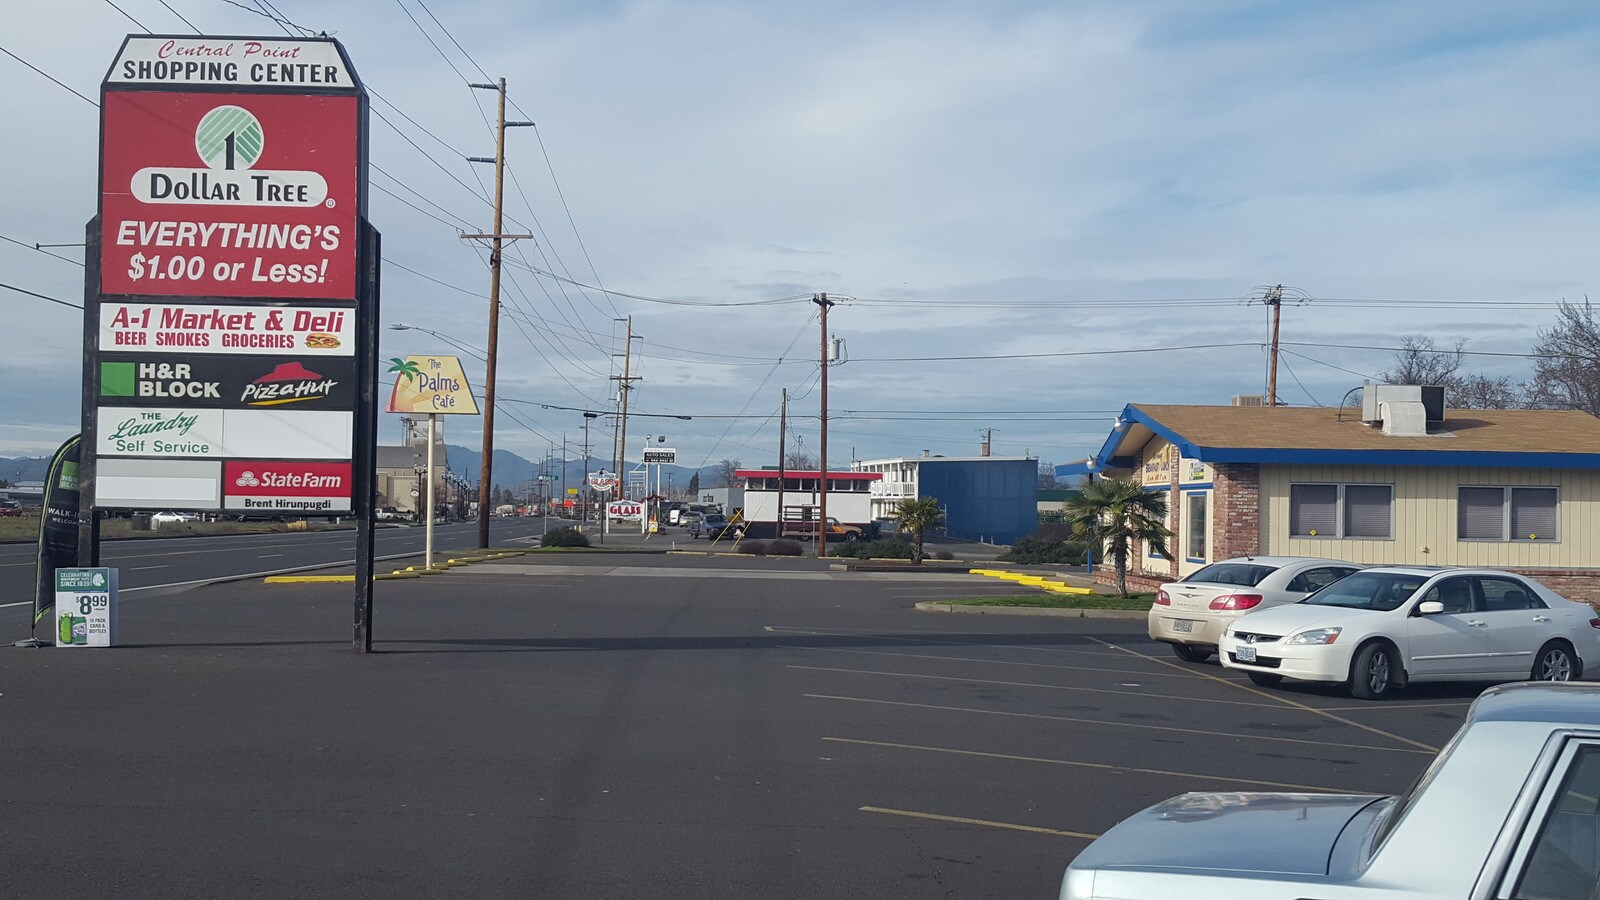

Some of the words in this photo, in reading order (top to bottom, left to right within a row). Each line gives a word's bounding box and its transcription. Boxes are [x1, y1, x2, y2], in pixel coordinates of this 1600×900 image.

[158, 40, 233, 59] Central
[243, 41, 301, 59] Point
[123, 60, 238, 81] SHOPPING
[250, 62, 338, 83] CENTER
[116, 220, 340, 251] EVERYTHING'S
[128, 252, 205, 282] $1.00
[213, 262, 245, 281] or
[251, 257, 329, 283] Less!
[110, 306, 151, 329] A-1
[159, 307, 258, 331] Market
[265, 310, 285, 332] &
[292, 311, 345, 333] Deli
[115, 331, 147, 346] BEER
[155, 332, 210, 347] SMOKES
[221, 333, 295, 349] GROCERIES
[139, 362, 191, 380] H&R
[427, 358, 442, 369] The
[139, 380, 221, 398] BLOCK
[416, 372, 460, 393] Palms
[432, 394, 455, 410] Café
[140, 412, 162, 421] THE
[108, 411, 199, 441] Laundry
[116, 440, 146, 453] Self
[153, 441, 210, 454] Service
[60, 481, 80, 489] BLOC
[244, 498, 272, 509] Brent
[275, 499, 331, 511] Hirunpugdi
[610, 505, 641, 514] GLASS
[52, 516, 78, 525] WELCOM
